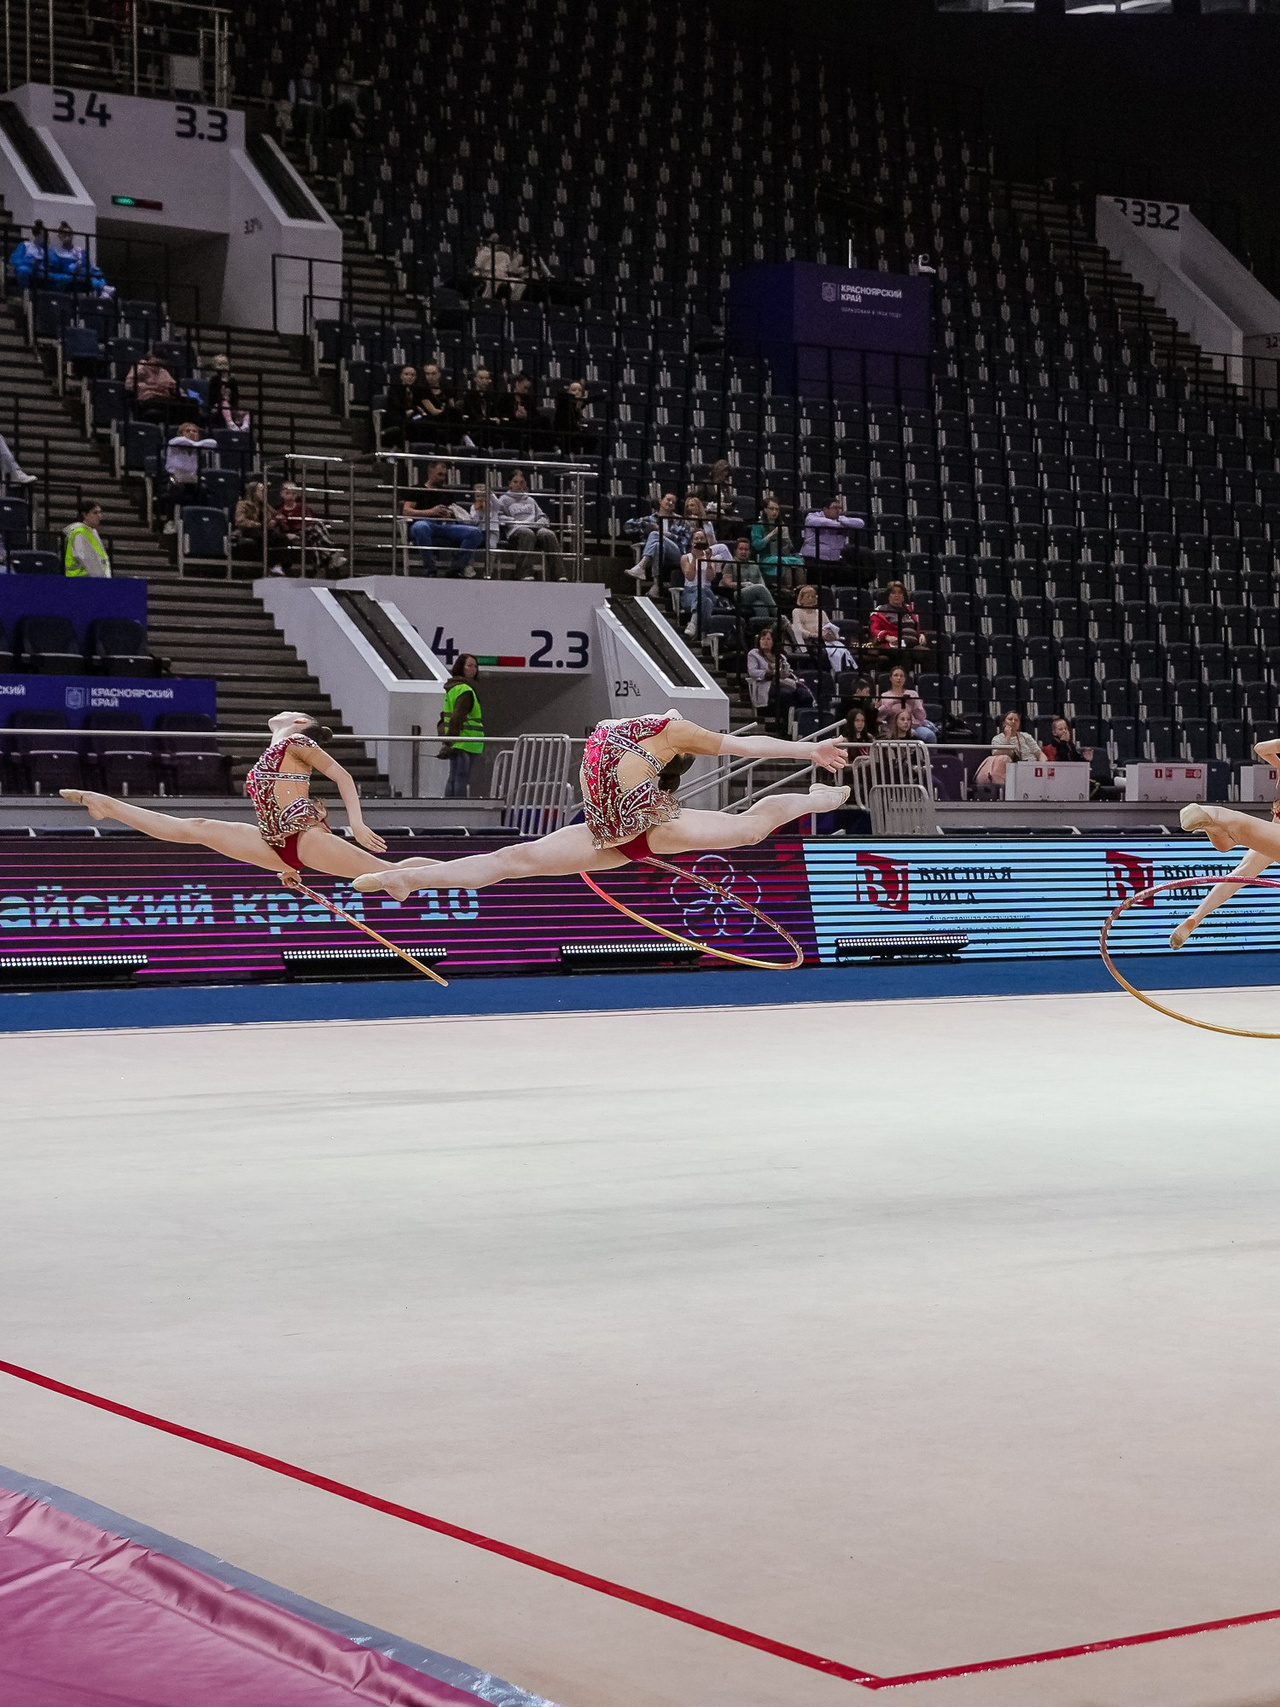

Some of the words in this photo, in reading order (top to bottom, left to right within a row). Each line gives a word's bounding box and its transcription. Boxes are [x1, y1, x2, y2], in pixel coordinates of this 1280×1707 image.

[53, 88, 112, 127] 3.4
[175, 104, 228, 142] 3.3
[840, 284, 902, 299] КРАСНОЯРСКИЙ
[840, 293, 862, 303] КРАЙ
[529, 629, 590, 669] 2.3
[91, 687, 174, 699] КРАСНОЯРСКИЙ
[91, 697, 119, 708] КРАЙ
[418, 888, 479, 920] 10
